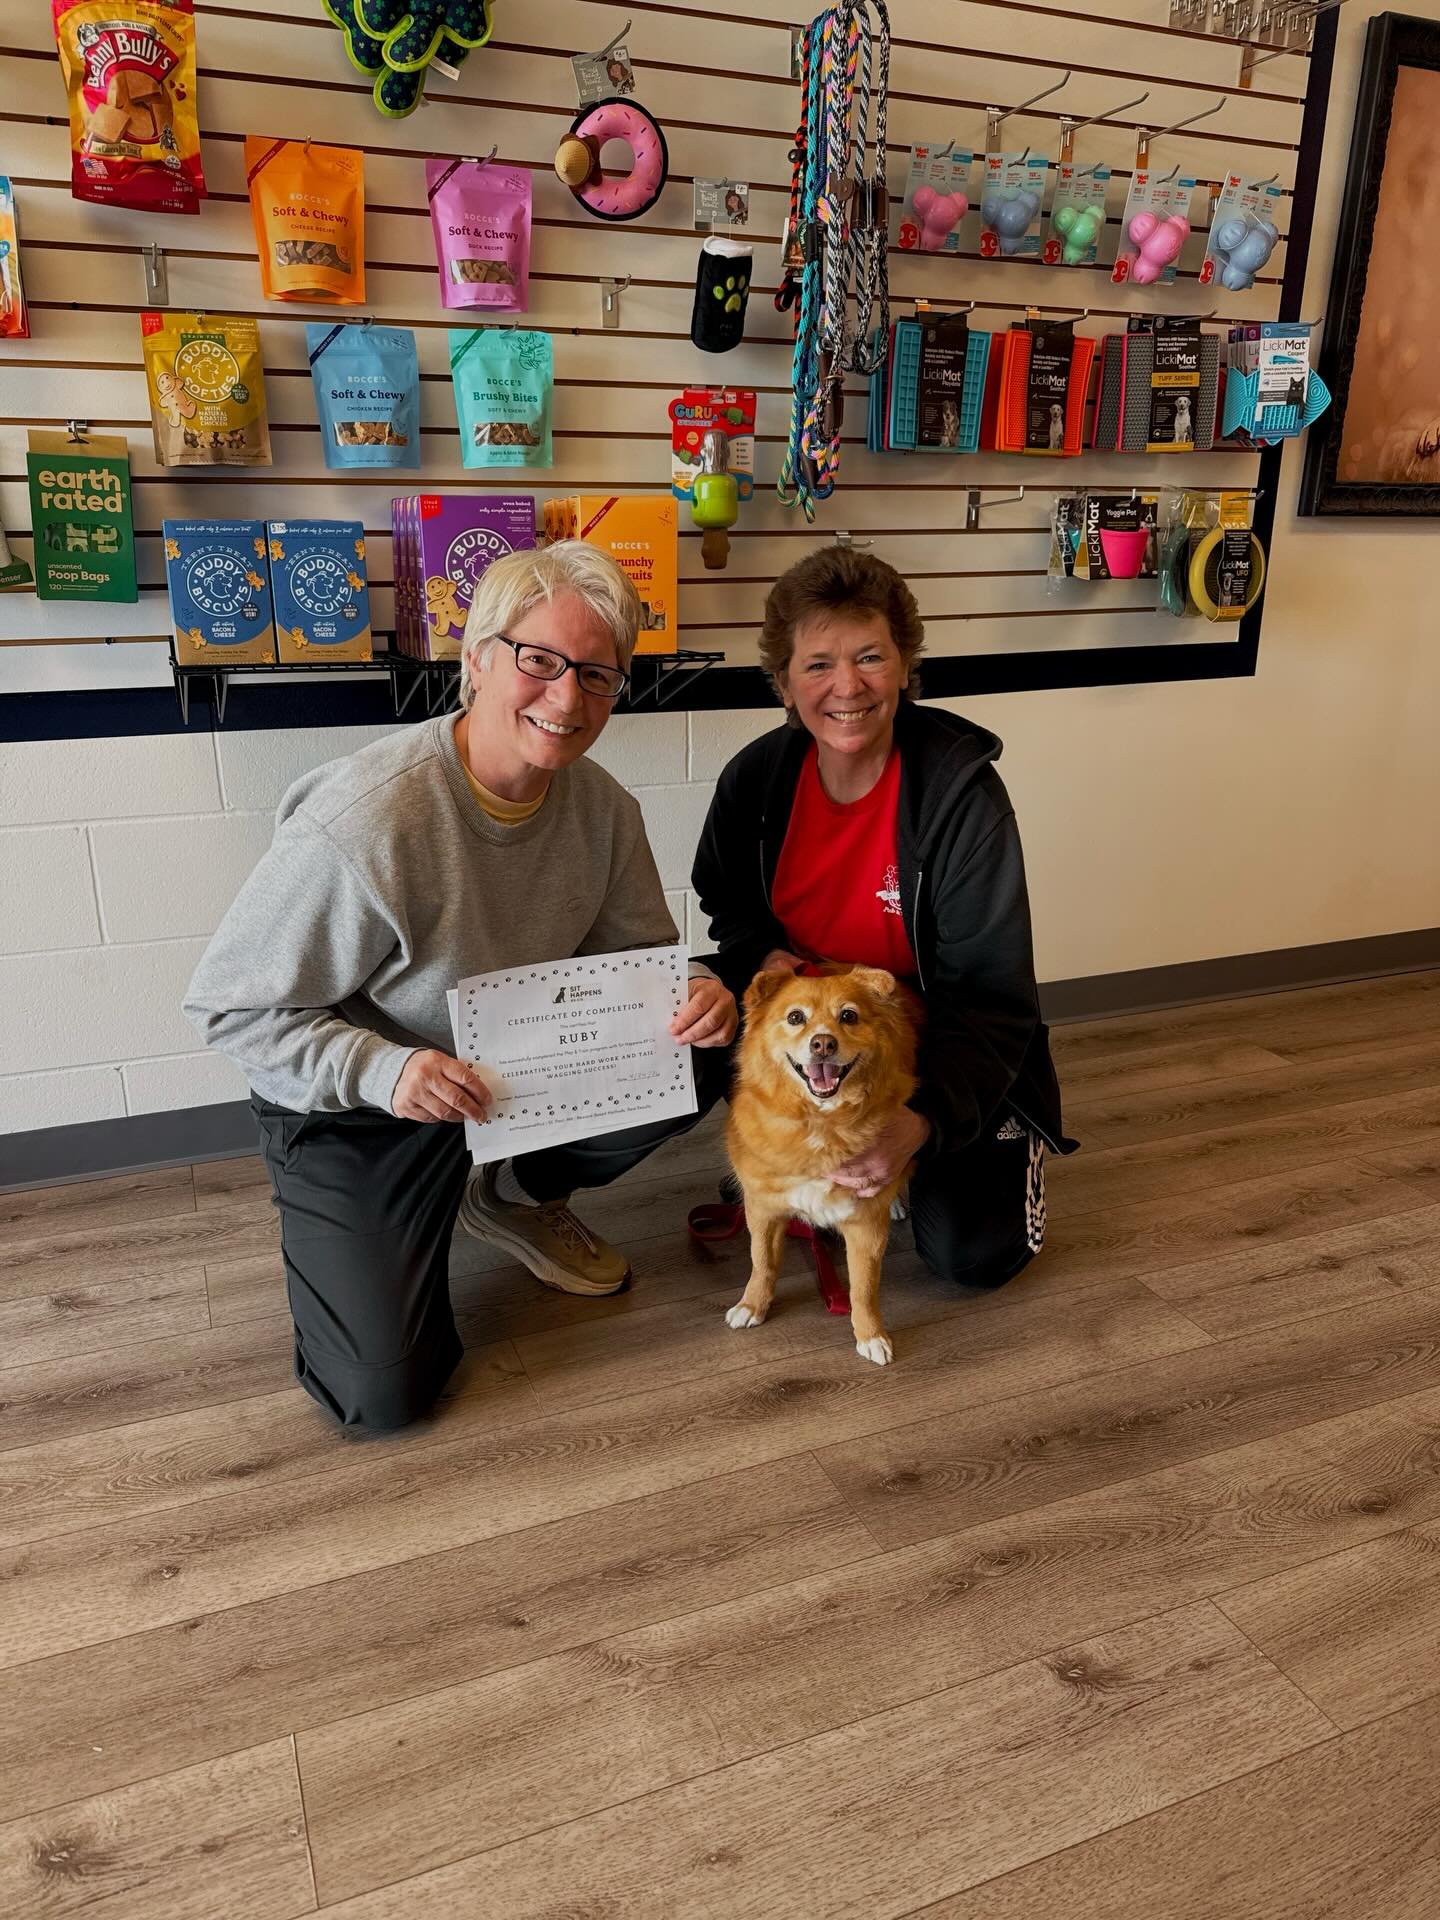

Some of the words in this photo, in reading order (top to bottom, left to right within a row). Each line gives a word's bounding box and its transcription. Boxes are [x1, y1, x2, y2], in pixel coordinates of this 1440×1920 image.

[87, 38, 115, 88] Benny
[114, 33, 172, 70] Bully's
[272, 206, 296, 217] Soft
[300, 208, 309, 217] &
[313, 210, 350, 226] Chewy
[315, 226, 336, 234] RECIPE
[448, 226, 471, 236] Soft
[473, 228, 482, 237] &
[484, 229, 519, 243] Chewy
[1263, 339, 1306, 351] LickiMat
[182, 343, 230, 364] BUDDY
[1156, 353, 1197, 365] LickiMat
[347, 375, 387, 383] BOCCE'S
[487, 378, 522, 386] BOCCE'S
[923, 367, 962, 382] LickiMat
[1030, 374, 1067, 387] LickiMat
[184, 375, 237, 400] SOFTIES
[331, 389, 354, 399] Soft
[357, 390, 366, 399] &
[368, 390, 406, 402] Chewy
[473, 392, 510, 403] Brushy
[512, 393, 538, 402] Bites
[38, 468, 121, 492] earth
[41, 490, 123, 513] rated
[1106, 509, 1126, 518] Yoggie
[1086, 502, 1102, 566] LickiMat
[453, 533, 509, 558] BUDDY
[611, 542, 651, 550] BOCCE'S
[181, 545, 214, 571] TEENY
[284, 546, 317, 571] TEENY
[616, 556, 654, 569] runchy
[1222, 560, 1249, 570] LickiMat
[194, 557, 243, 578] BUDDY
[297, 559, 344, 579] BUDDY
[627, 570, 653, 580] cuits
[1236, 569, 1249, 577] UFO
[0, 574, 21, 584] enser
[48, 570, 79, 582] Poop
[81, 571, 110, 584] Bags
[192, 585, 249, 612] BISCUITS
[294, 586, 349, 612] BISCUITS
[570, 989, 602, 998] HAPPENS
[507, 1011, 568, 1026] CERTIFICATE
[571, 1010, 583, 1018] OF
[586, 1002, 645, 1017] COMPLETION
[559, 1030, 599, 1045] RUBY
[502, 1066, 552, 1079] CELEBRATING
[554, 1062, 574, 1072] YOUR
[576, 1060, 596, 1068] HARD
[598, 1055, 620, 1064] WORK
[621, 1052, 637, 1060] AND
[546, 1069, 582, 1080] WAGGING
[584, 1064, 617, 1074] SUCCESS!
[996, 1129, 1027, 1140] adidas
